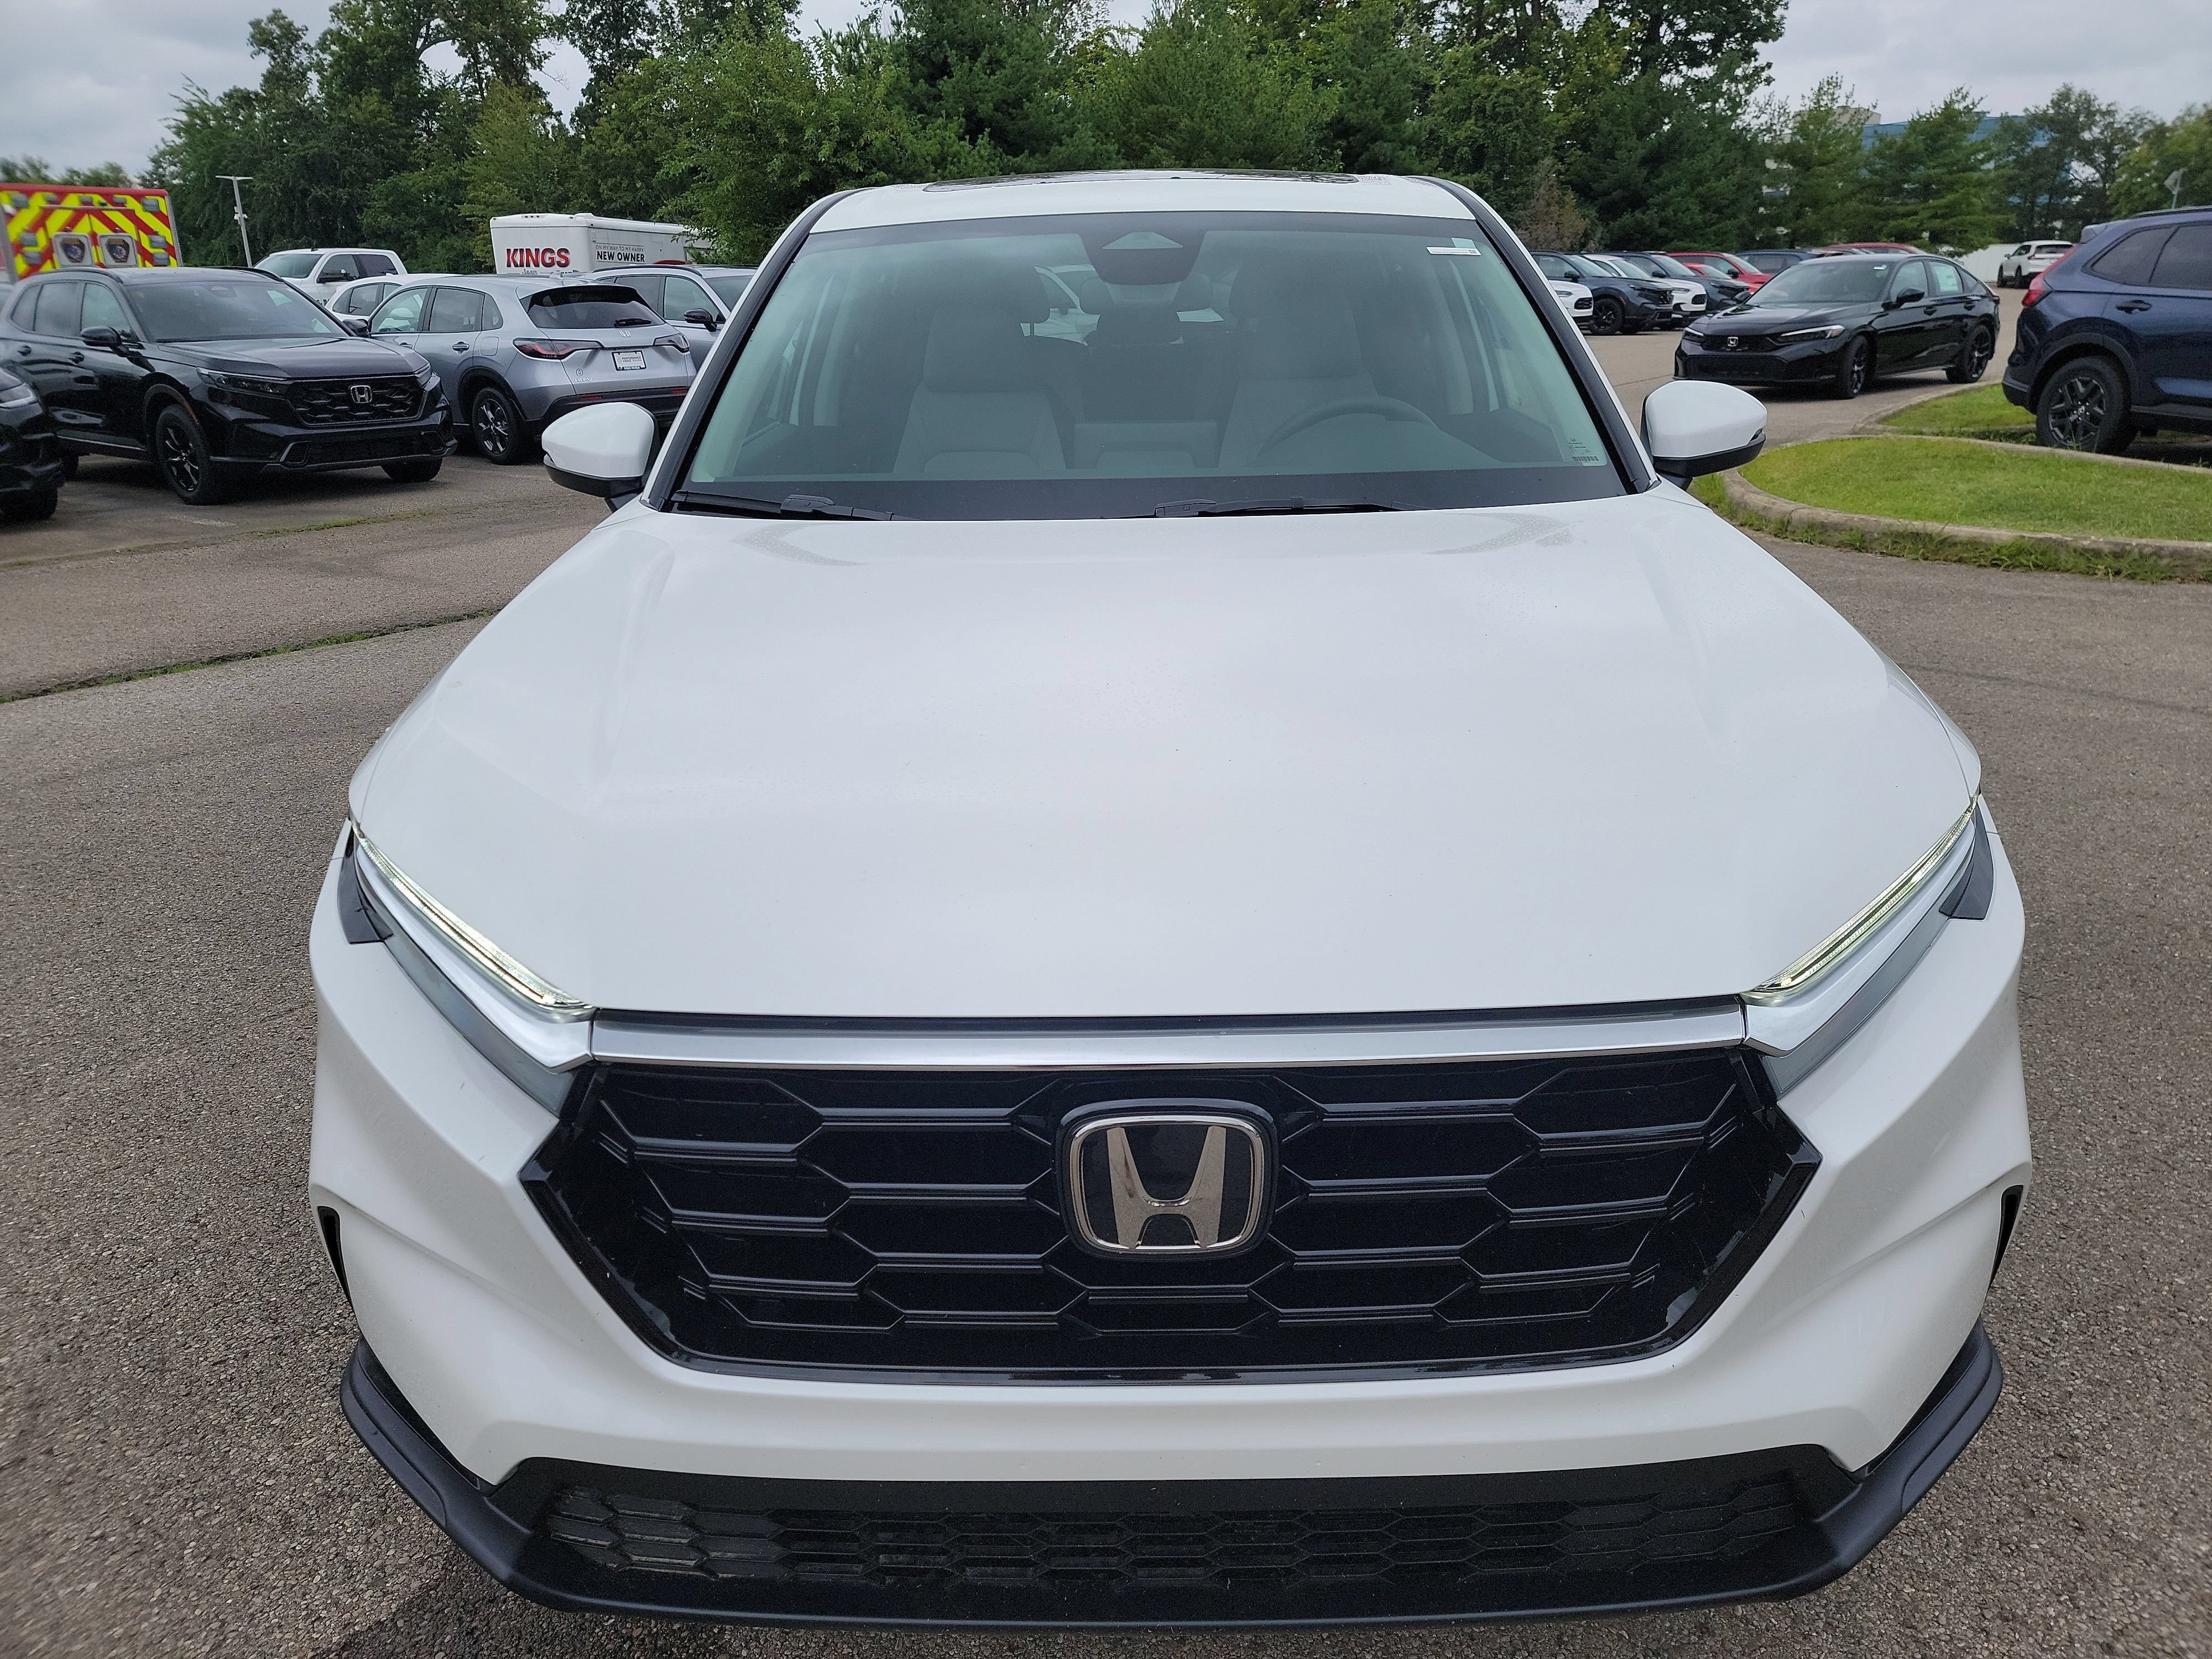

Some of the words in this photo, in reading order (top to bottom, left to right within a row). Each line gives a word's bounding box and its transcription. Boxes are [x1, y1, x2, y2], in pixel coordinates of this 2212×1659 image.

[506, 248, 570, 267] KINGS
[597, 251, 614, 260] NEW
[617, 252, 645, 262] OWNER
